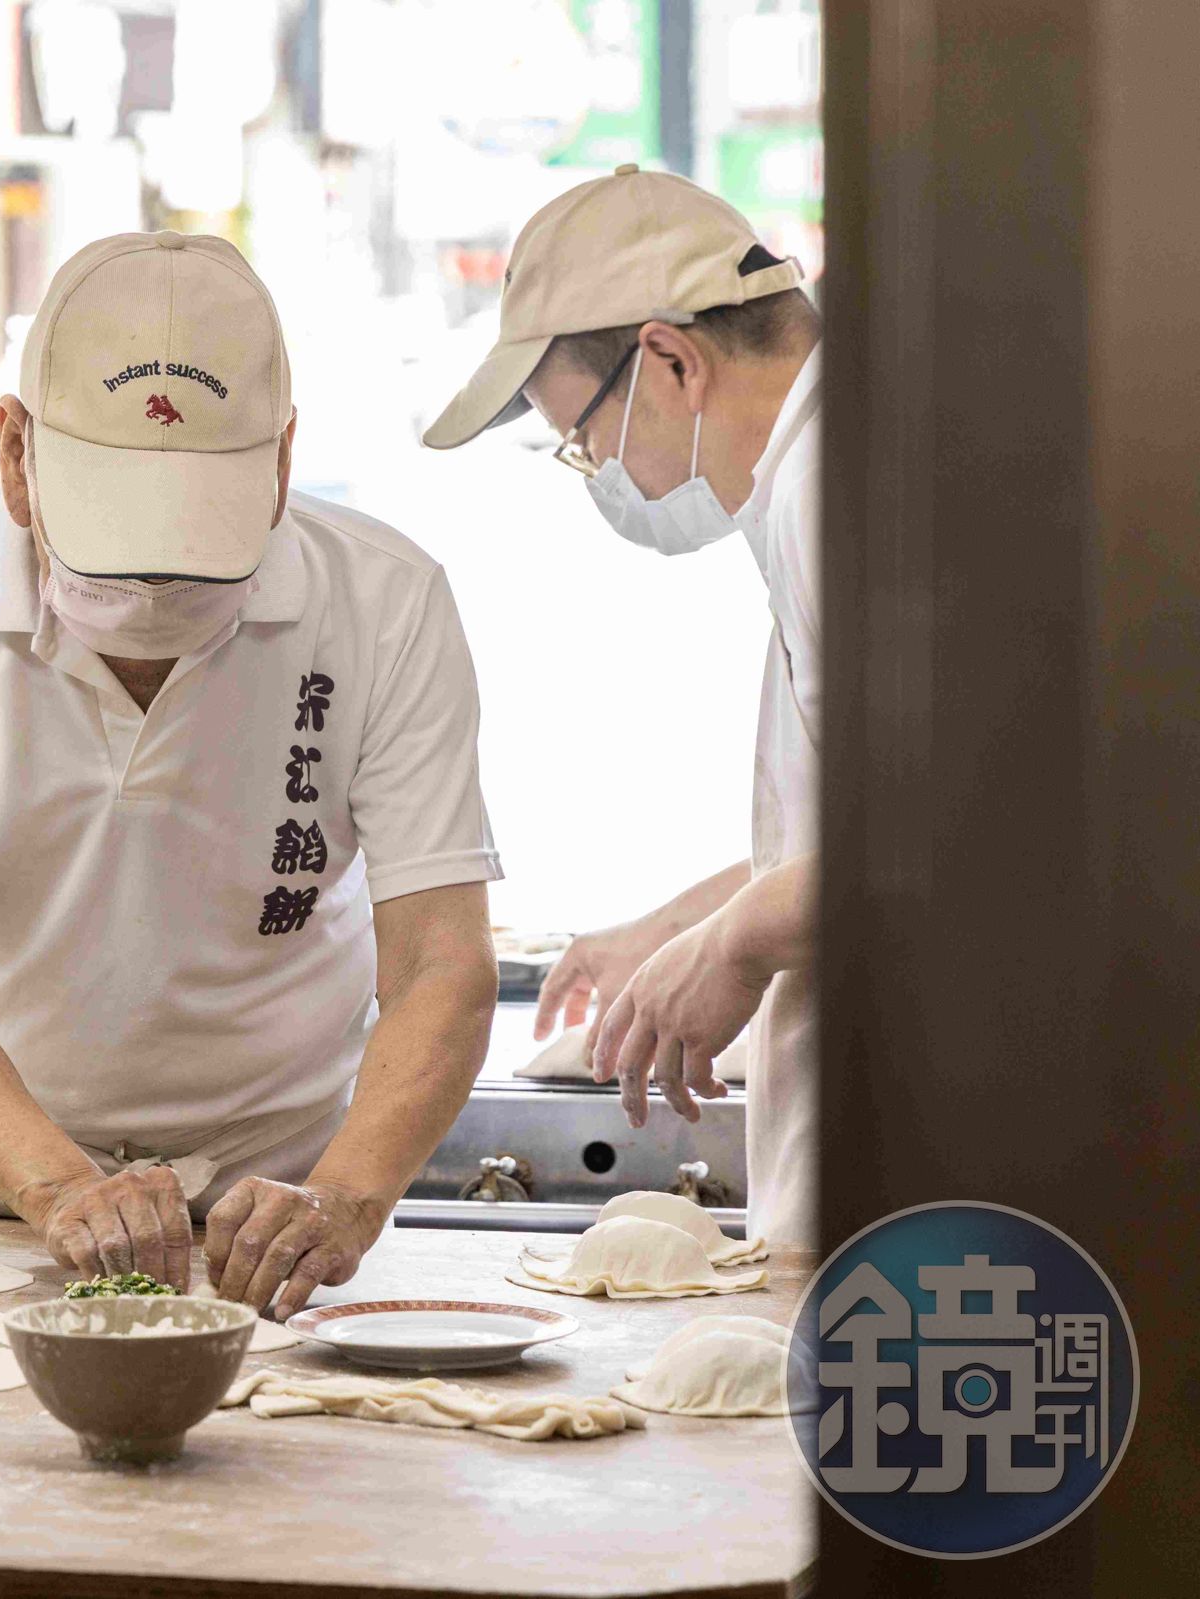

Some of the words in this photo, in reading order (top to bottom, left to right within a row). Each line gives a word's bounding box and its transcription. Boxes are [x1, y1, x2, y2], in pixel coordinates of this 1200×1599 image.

[103, 360, 161, 393] instant
[165, 362, 228, 400] success
[258, 671, 334, 936] 宋江餡餅
